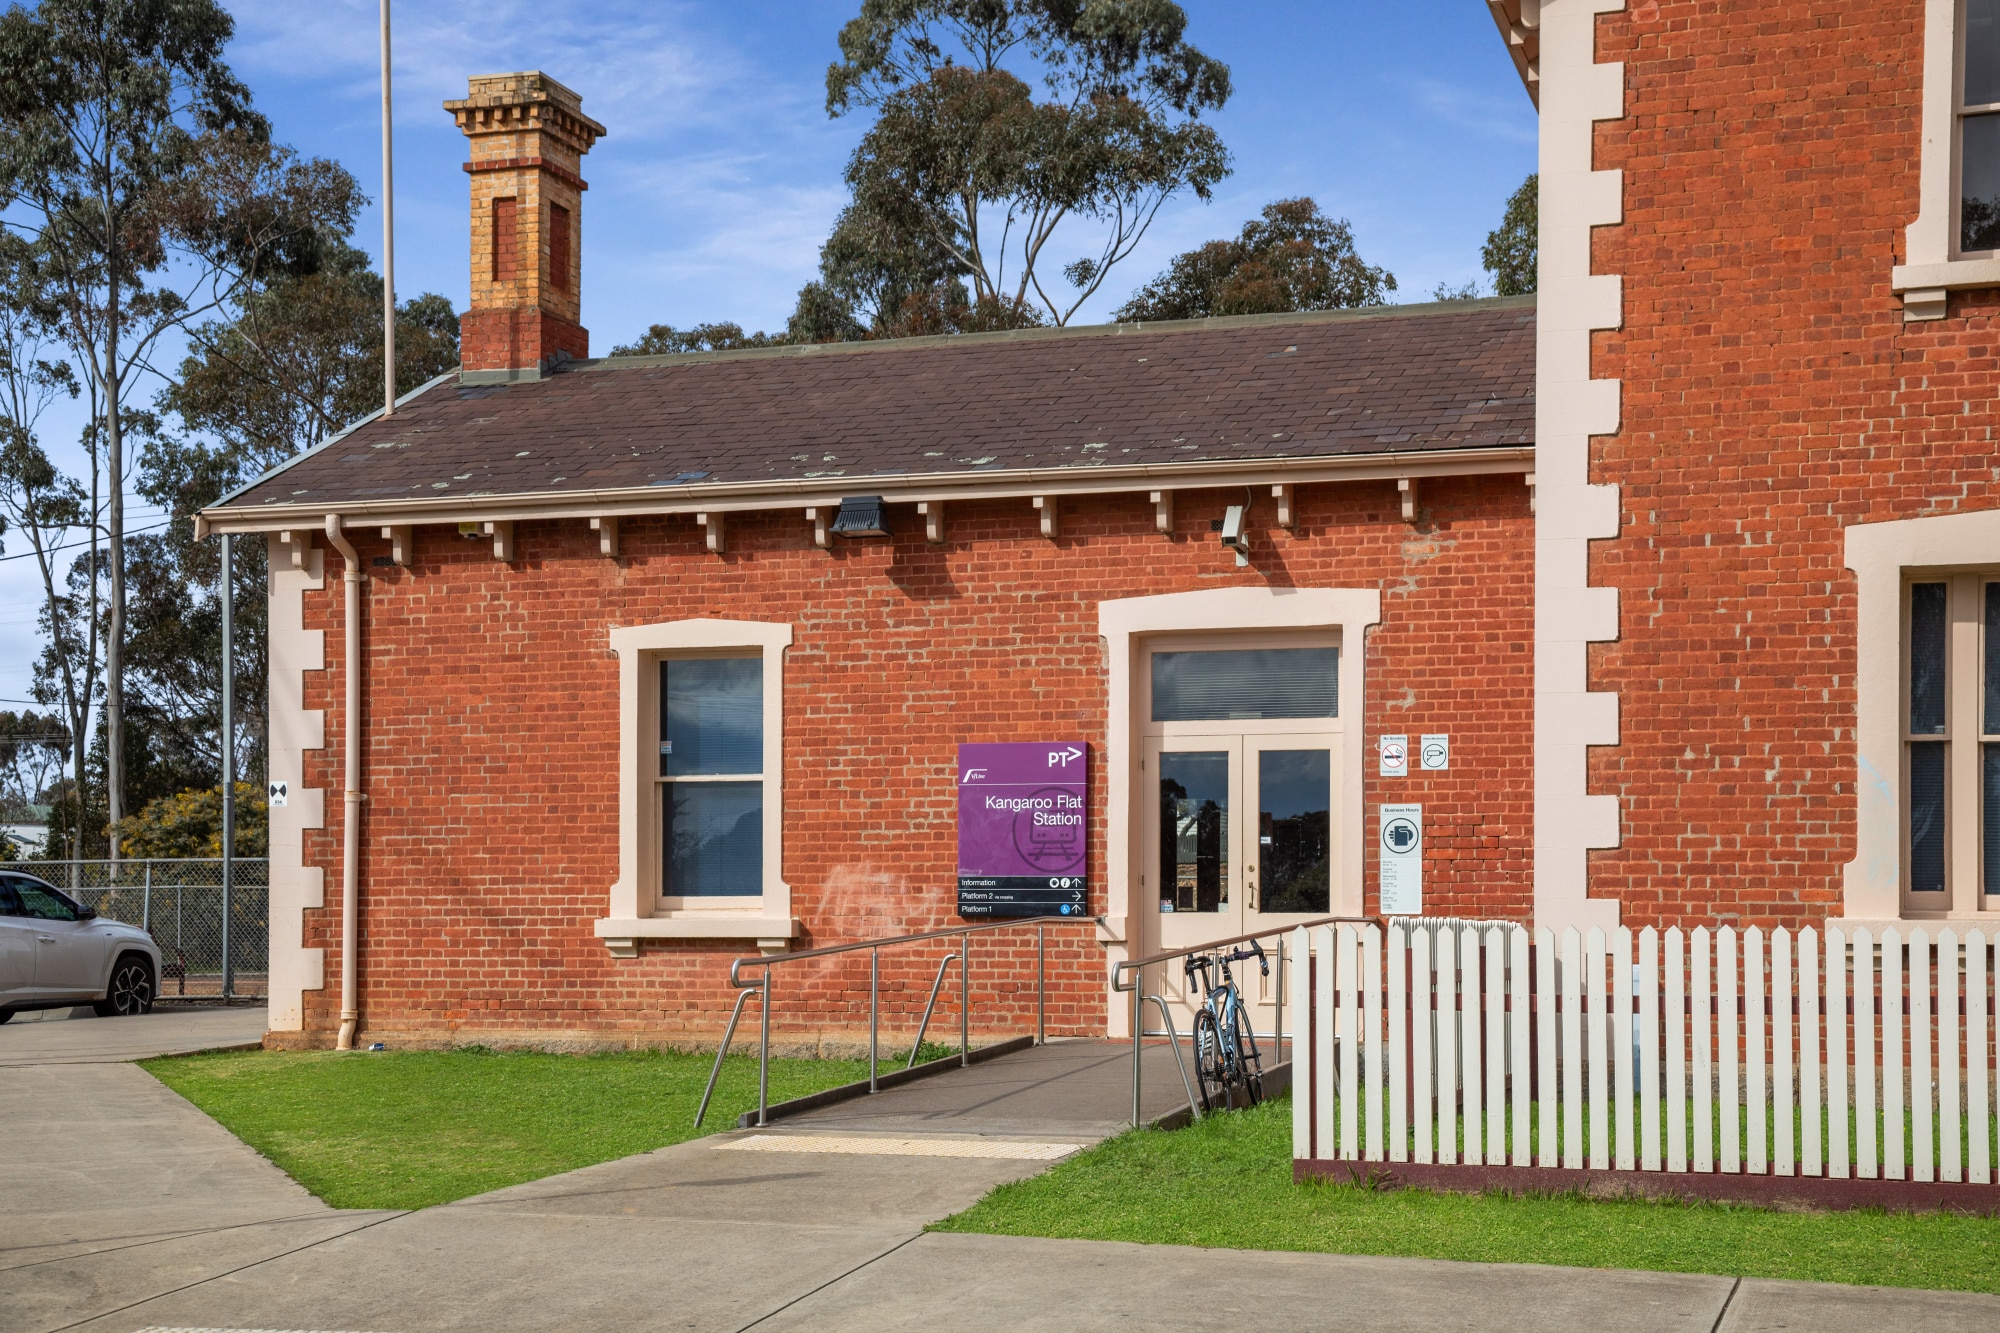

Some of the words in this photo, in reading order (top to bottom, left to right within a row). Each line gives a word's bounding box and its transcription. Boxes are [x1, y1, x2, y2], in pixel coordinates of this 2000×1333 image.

[985, 795, 1053, 812] Kangaroo
[1057, 794, 1083, 809] Flat
[1033, 811, 1082, 826] Station
[961, 892, 988, 900] Platform
[988, 892, 994, 900] 2
[961, 905, 988, 913] Platform
